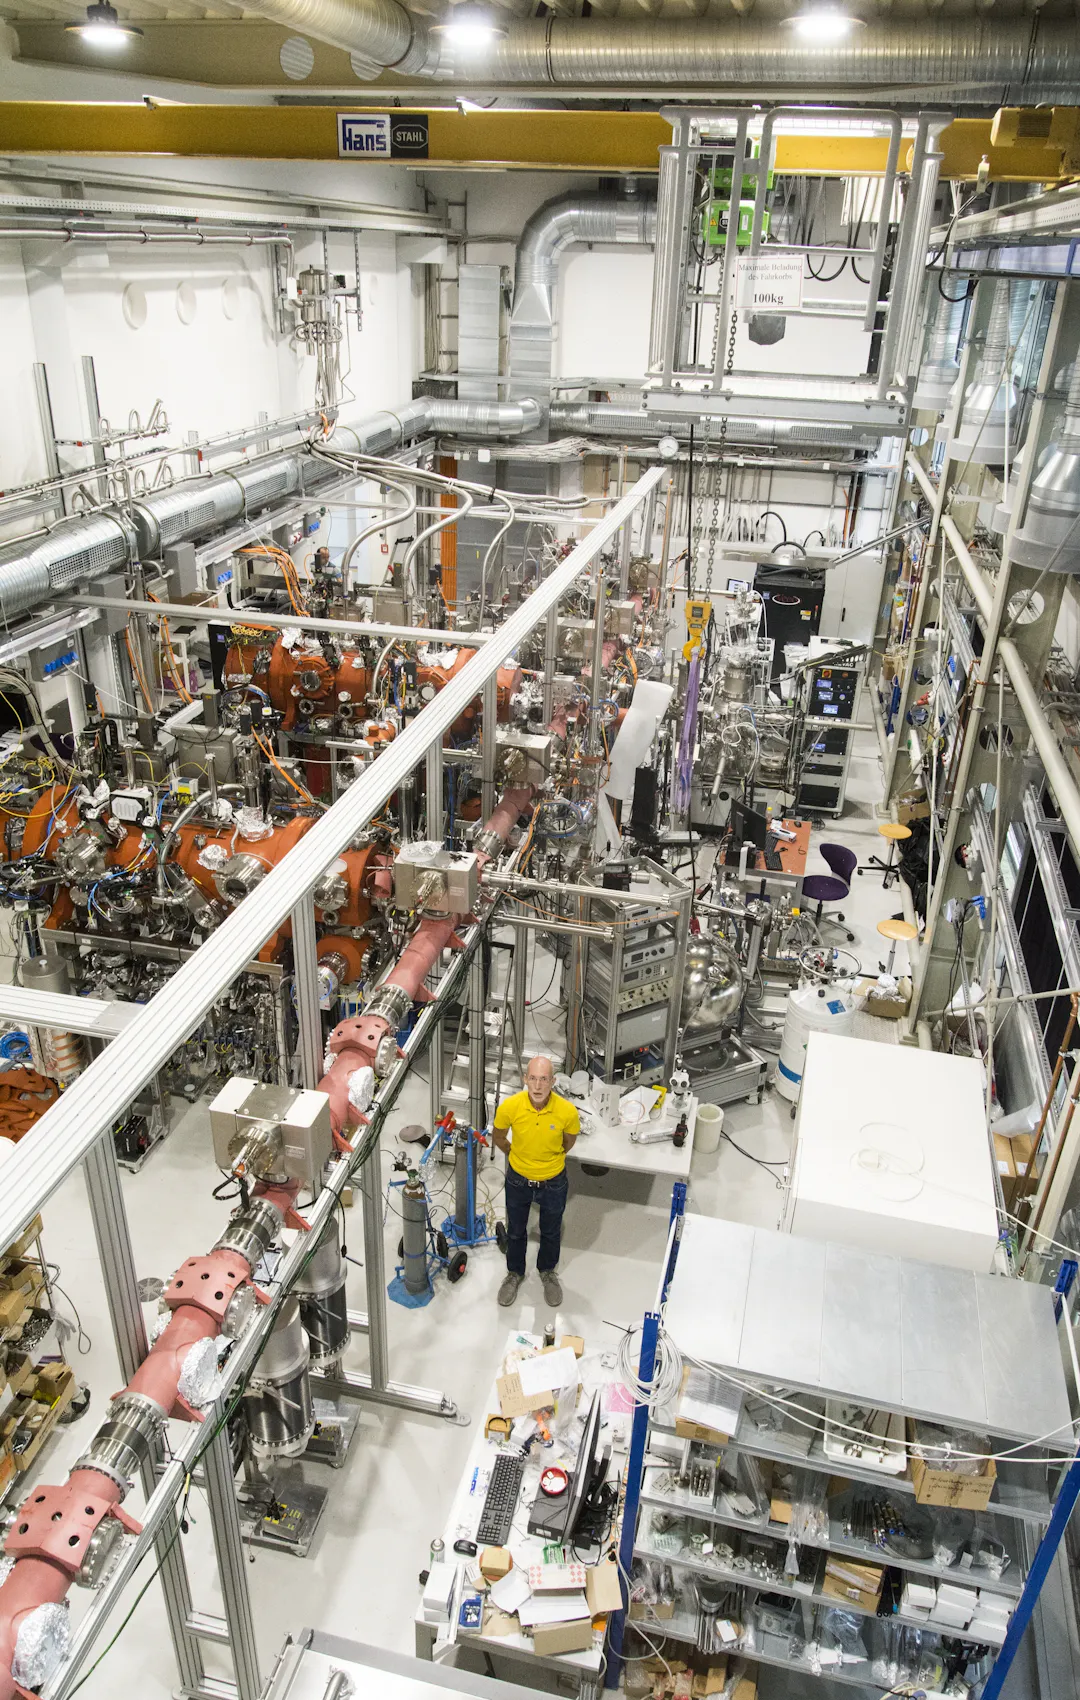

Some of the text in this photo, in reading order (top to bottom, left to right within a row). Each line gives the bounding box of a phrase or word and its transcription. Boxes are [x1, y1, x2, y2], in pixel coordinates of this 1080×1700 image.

[342, 119, 386, 151] Hans
[396, 131, 424, 142] STAHL
[772, 263, 802, 272] Beladung
[754, 293, 784, 305] 100kg
